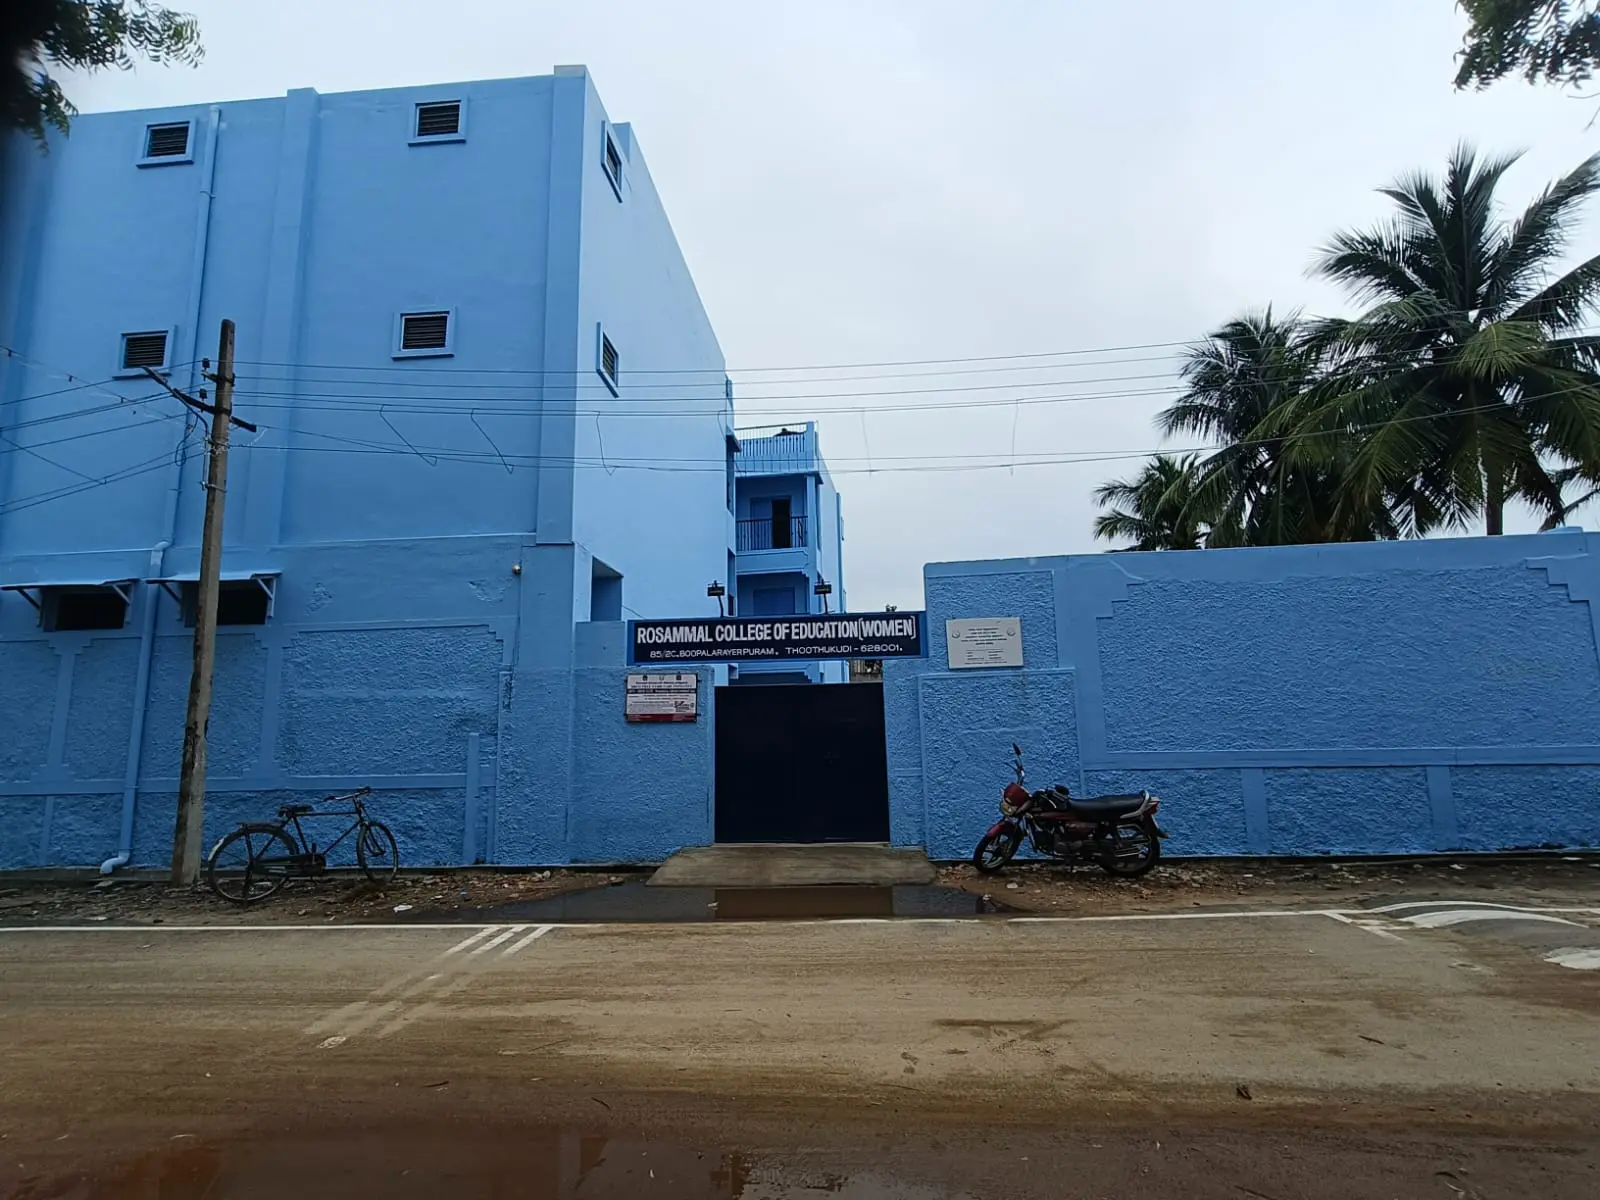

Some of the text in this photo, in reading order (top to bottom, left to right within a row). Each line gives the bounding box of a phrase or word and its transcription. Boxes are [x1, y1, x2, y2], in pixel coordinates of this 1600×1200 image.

[637, 625, 713, 644] ROSAMMAL
[715, 624, 771, 641] COLLEGE
[773, 623, 789, 640] OF
